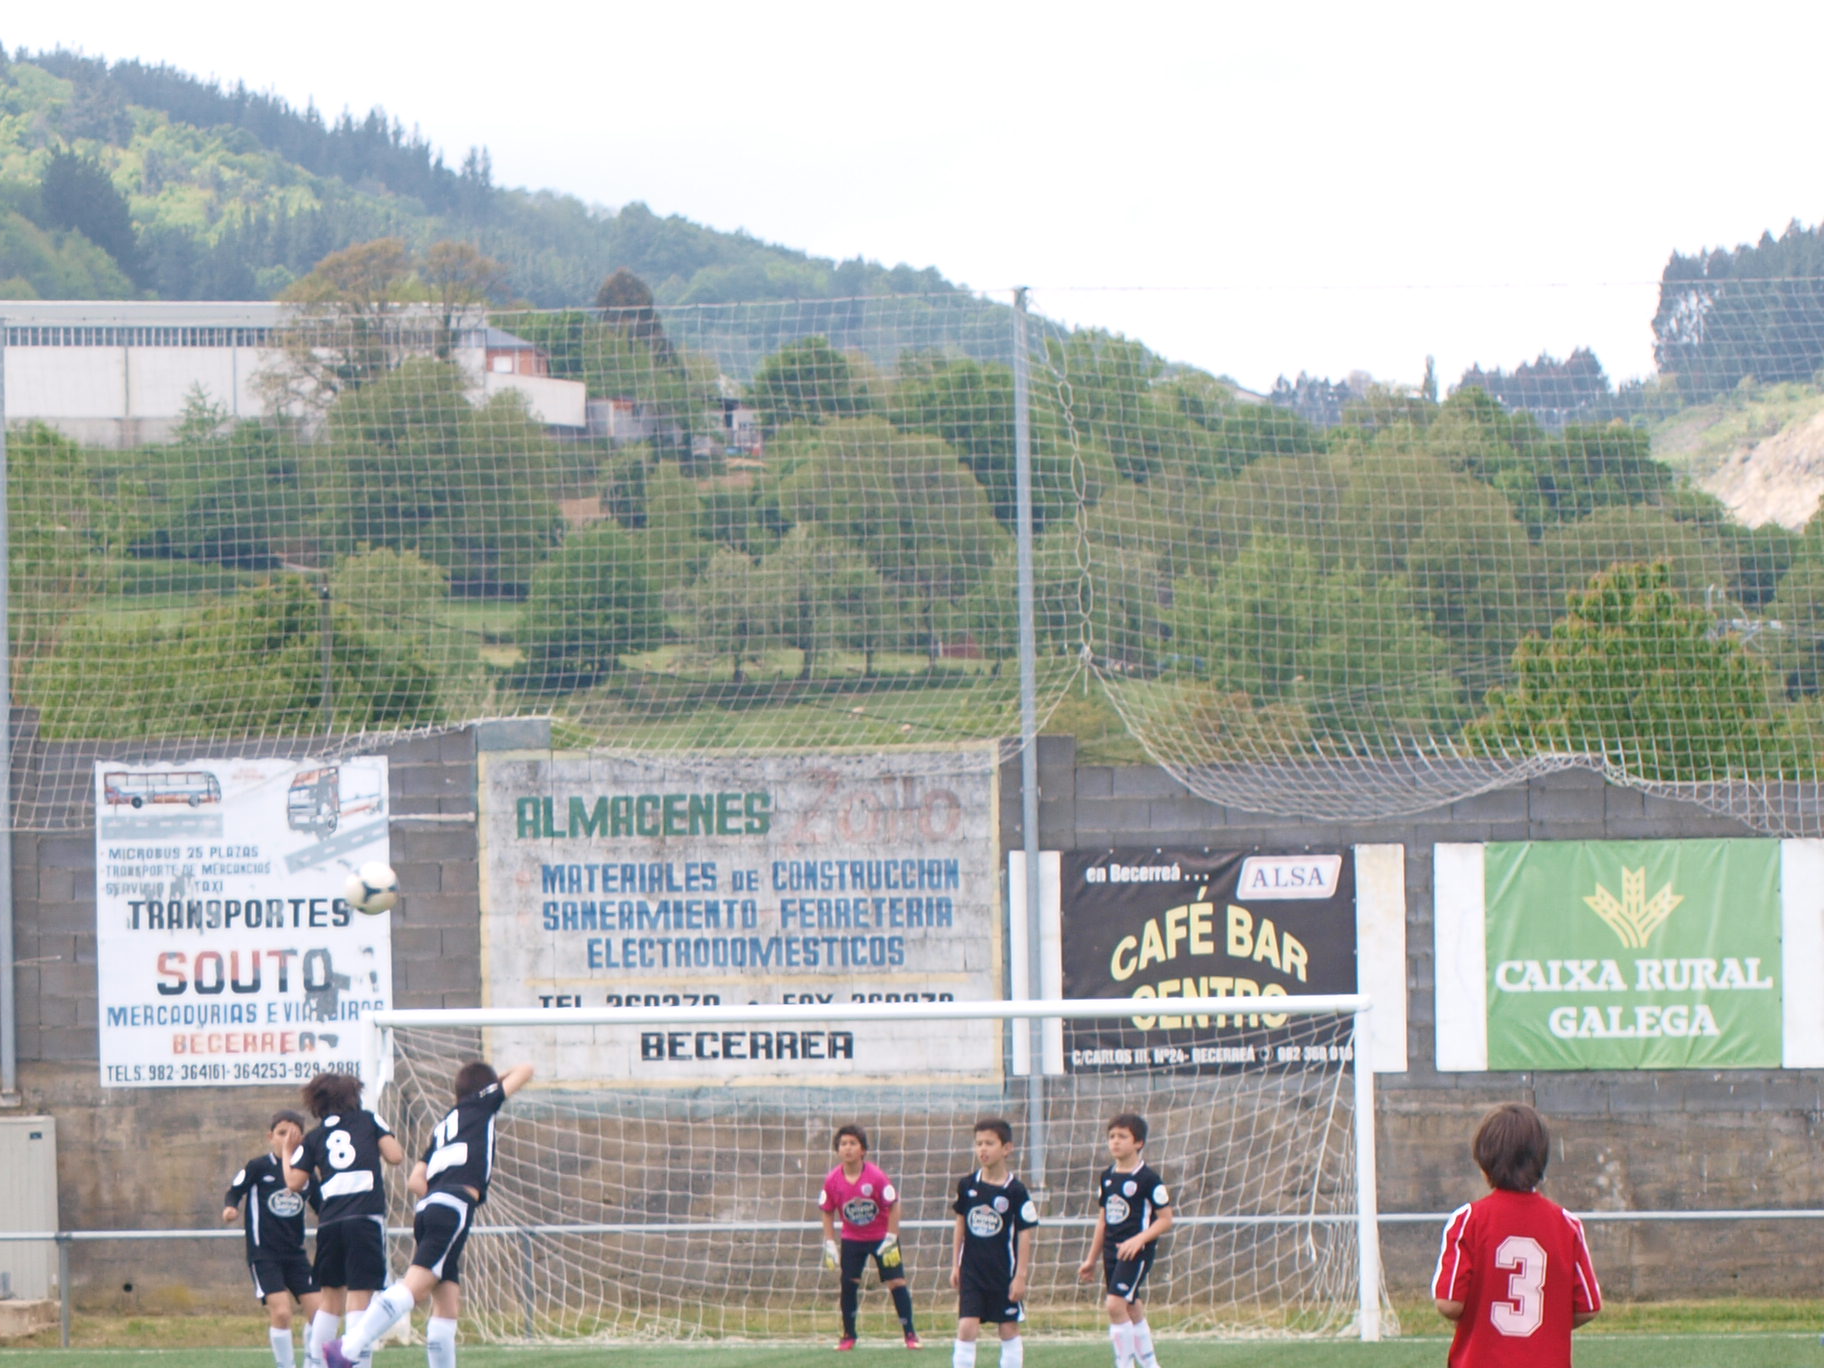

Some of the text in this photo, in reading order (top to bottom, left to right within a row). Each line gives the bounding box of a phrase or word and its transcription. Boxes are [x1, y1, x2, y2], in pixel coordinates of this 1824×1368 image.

[517, 793, 770, 839] ALMACENES
[108, 845, 259, 860] MICROBUS 25 PLAZAS
[106, 865, 177, 877] TRANSPORTE
[194, 880, 223, 892] TAXI
[542, 859, 959, 893] MATERIALES DE CONSTRUCCION
[1086, 867, 1106, 882] en
[1110, 863, 1180, 882] Becerreá
[1252, 867, 1326, 888] ALSA
[127, 898, 351, 930] TRANSPORTES
[543, 898, 953, 931] SANEAMIENTO FERRETERIA
[1111, 886, 1308, 982] CAFÉ BAR
[587, 937, 905, 968] ELECTRODOMESTICOS
[156, 947, 332, 996] SOUTO
[1495, 958, 1773, 992] CAIXA RURAL
[107, 1003, 257, 1027] MERCADURIAS
[1548, 1005, 1720, 1038] GALEGA
[641, 1031, 854, 1061] BECERREA
[325, 1129, 356, 1170] 8
[1490, 1236, 1547, 1338] 3
